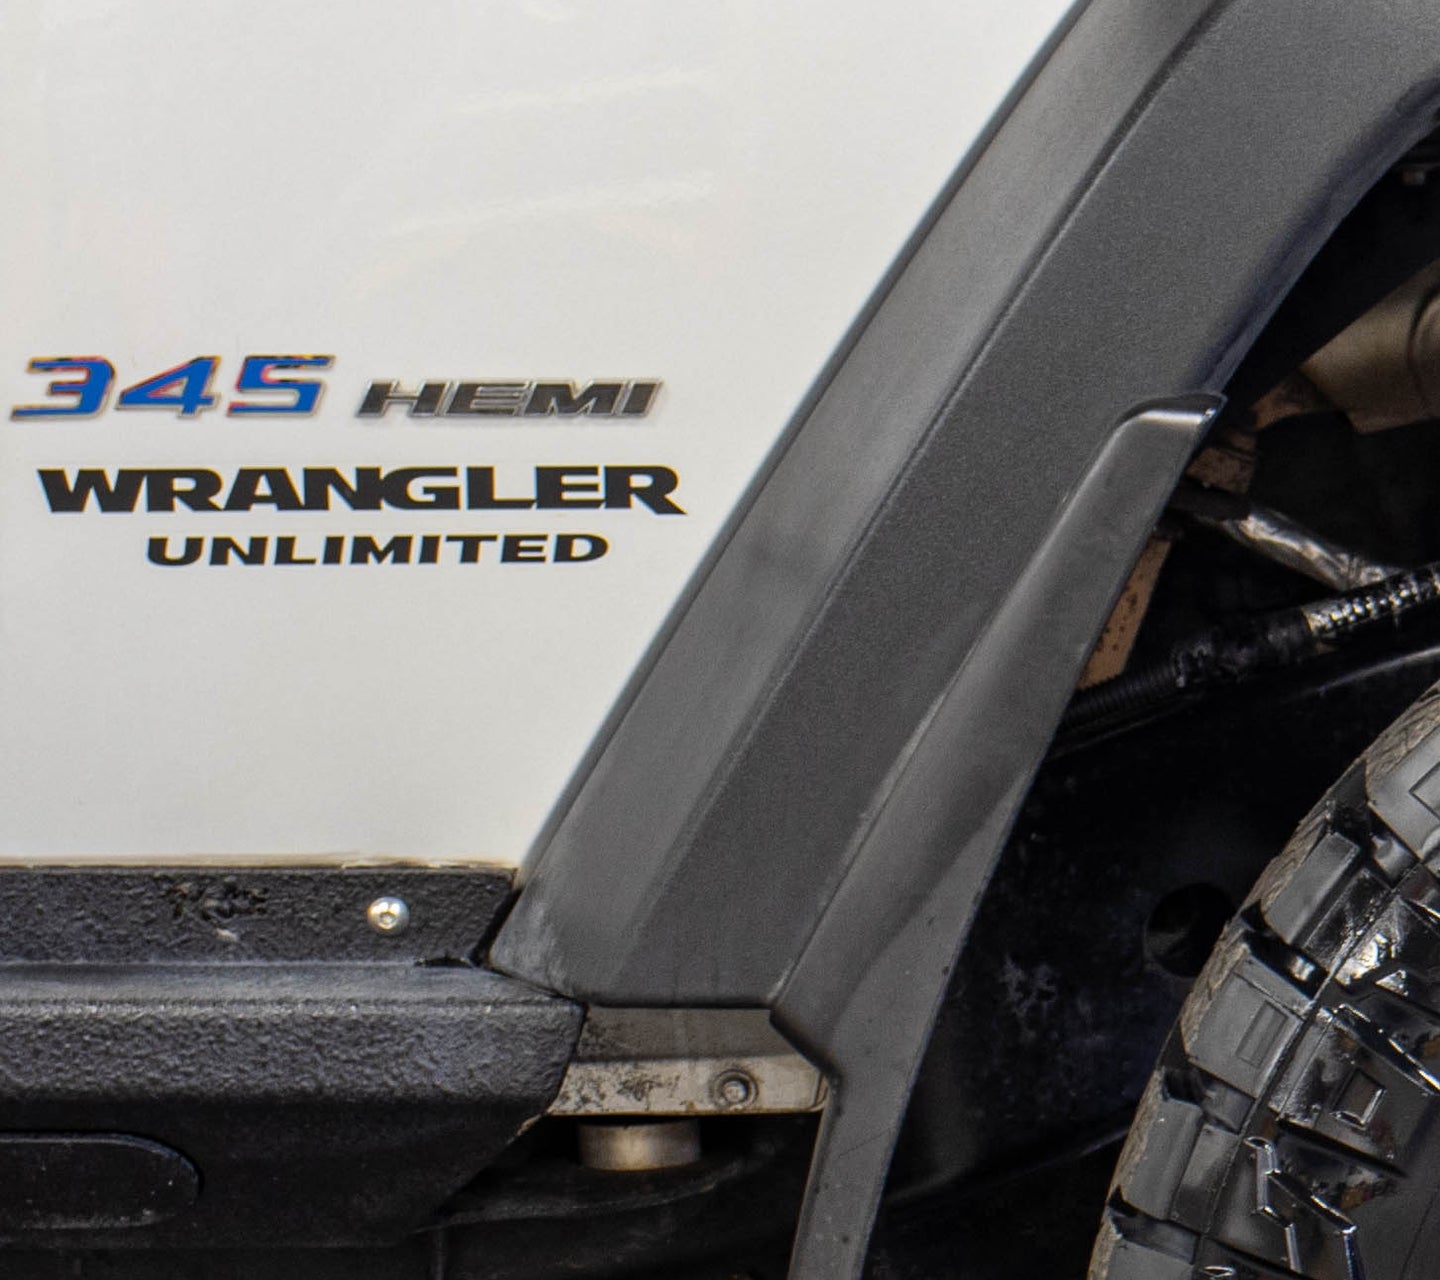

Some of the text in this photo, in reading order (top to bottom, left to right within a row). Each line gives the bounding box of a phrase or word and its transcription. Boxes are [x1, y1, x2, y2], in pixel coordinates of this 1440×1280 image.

[10, 355, 664, 419] 345 HEMI
[37, 464, 688, 516] WRANGLER
[146, 533, 609, 566] UNLIMITED
